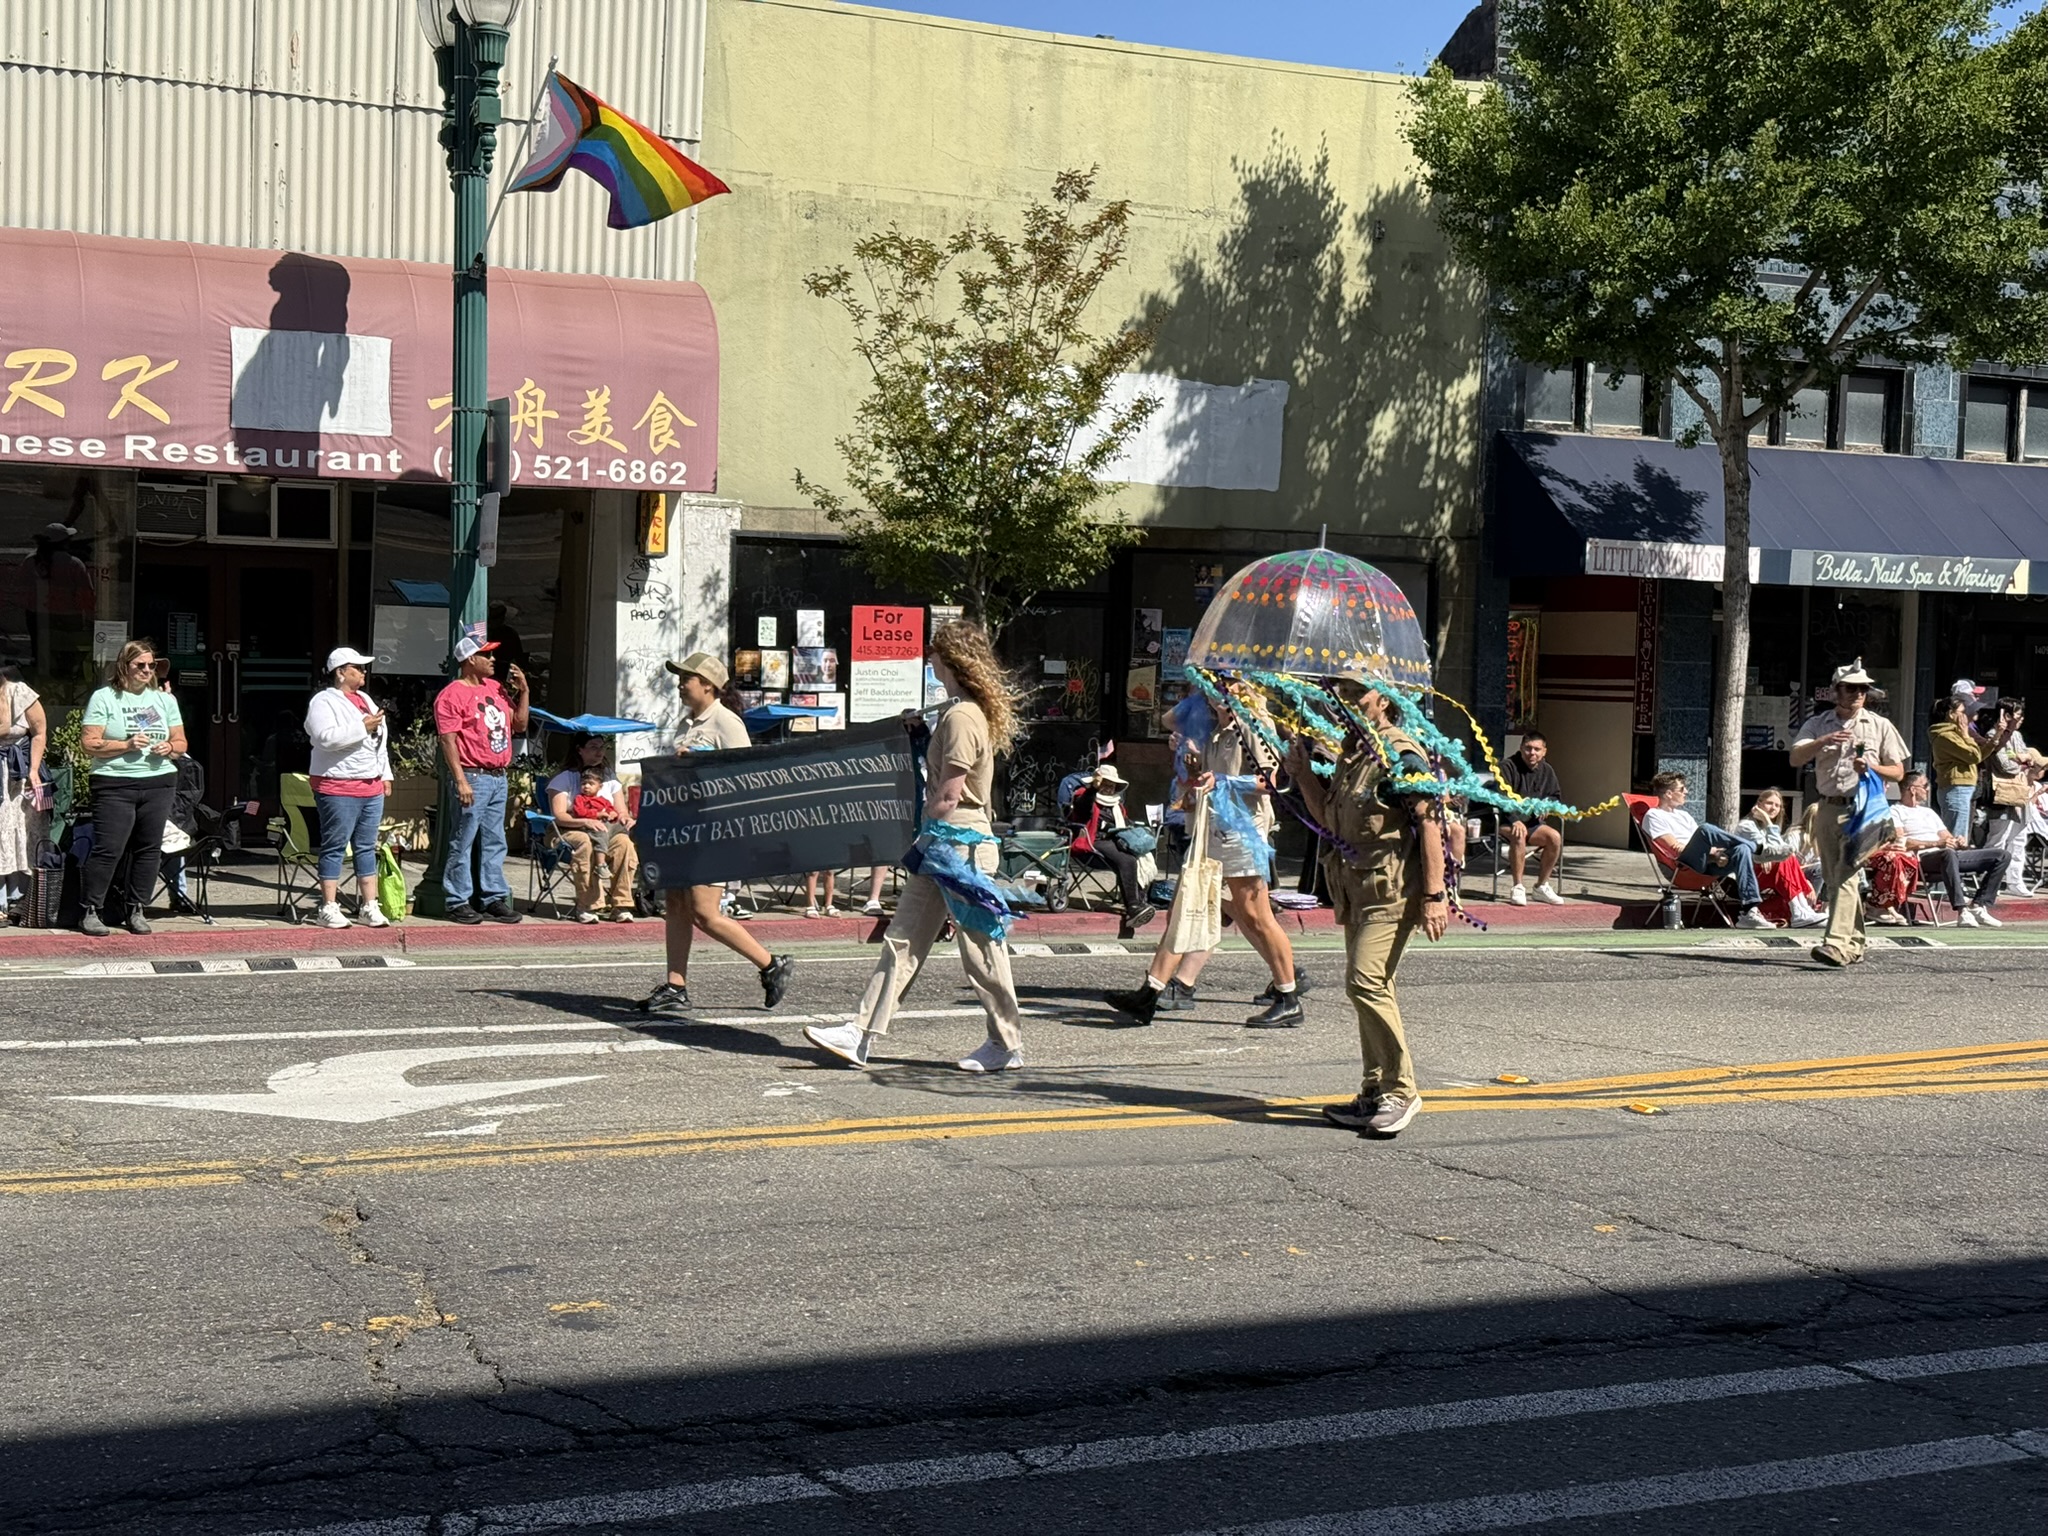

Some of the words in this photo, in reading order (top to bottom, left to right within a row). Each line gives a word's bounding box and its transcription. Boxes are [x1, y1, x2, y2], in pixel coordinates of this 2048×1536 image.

[124, 435, 403, 475] Restaurant
[533, 455, 687, 485] 521-6862
[1593, 546, 1645, 573] LITTLE
[1816, 554, 1862, 583] Bella
[1864, 556, 1904, 584] Nail
[1905, 561, 1934, 589] Spa
[1938, 560, 1952, 585] &
[1953, 556, 2006, 593] Waxing
[873, 609, 904, 625] For
[1642, 577, 1654, 638] RTUNE
[863, 626, 913, 642] Lease
[856, 646, 919, 657] 415.395.7262
[855, 668, 879, 676] Justin
[880, 668, 899, 676] Choi
[854, 688, 869, 696] Jeff
[1638, 661, 1650, 723] TELLER
[642, 785, 689, 807] DOUG
[691, 776, 736, 799] SIDEN
[735, 767, 793, 791] VISITOR
[792, 760, 845, 783] CENTER
[842, 758, 861, 776] AT
[859, 753, 892, 773] CRAB
[654, 823, 706, 847] EAST
[710, 817, 746, 841] BAY
[749, 806, 830, 835] REGIONAL
[829, 801, 868, 824] PARK
[866, 800, 913, 821] DISTRICT
